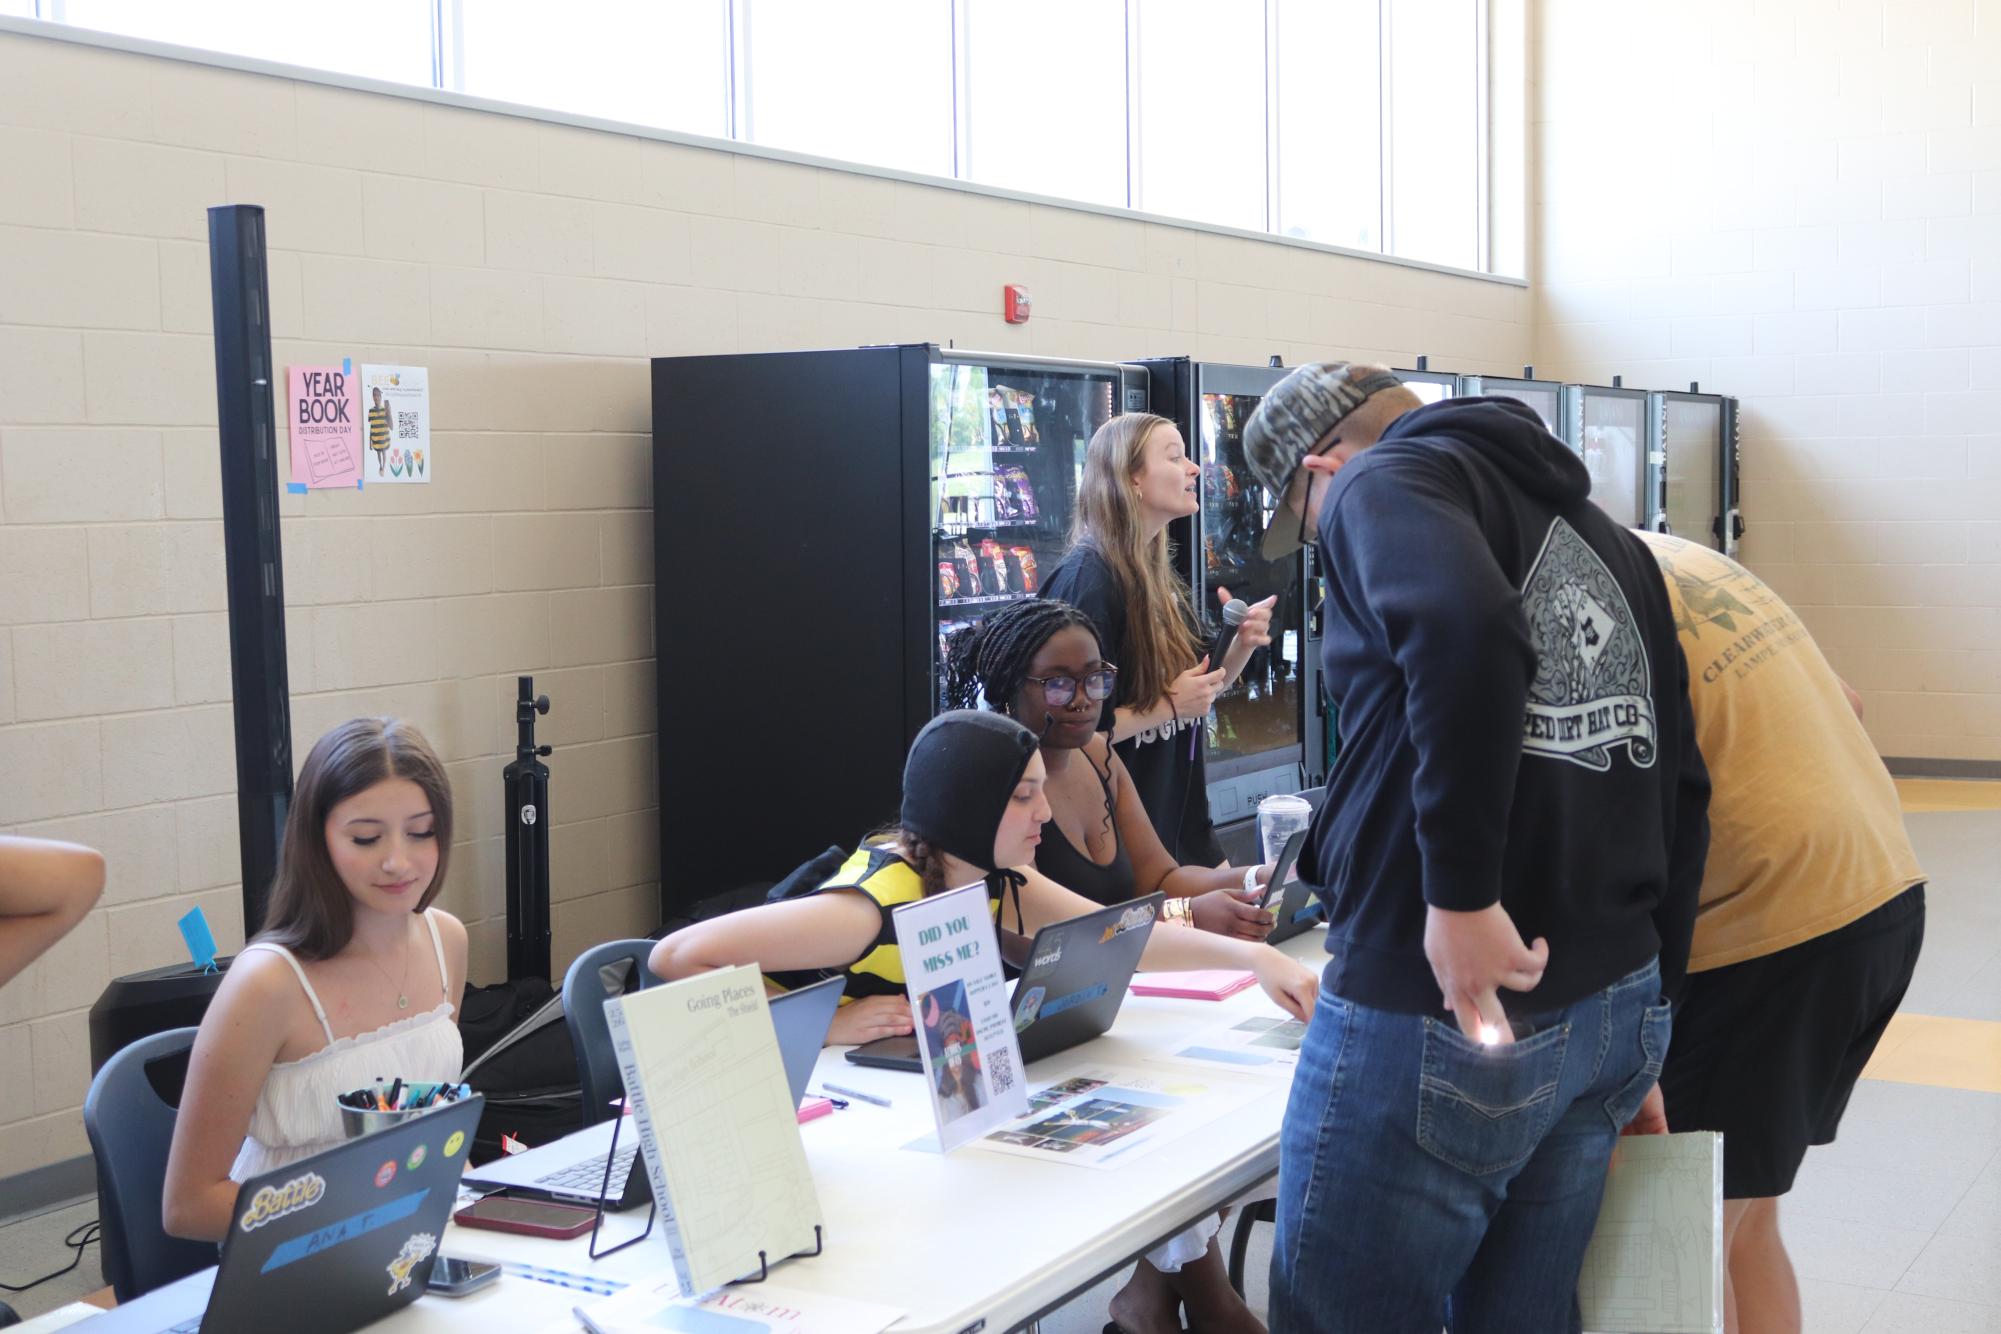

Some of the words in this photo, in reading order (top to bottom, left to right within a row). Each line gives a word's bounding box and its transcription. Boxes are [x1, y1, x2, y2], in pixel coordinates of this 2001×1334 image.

[303, 373, 344, 397] YEAR
[298, 399, 350, 424] BOOK
[298, 426, 338, 435] DISTRIBUTION
[339, 426, 352, 434] DAY
[1586, 705, 1611, 736] HAT
[918, 925, 942, 947] DID
[944, 915, 970, 937] YOU
[922, 949, 954, 974] MISS
[955, 940, 980, 962] ME?
[687, 993, 721, 1013] Going
[721, 985, 755, 1004] Places
[623, 1063, 645, 1115] Battle
[638, 1117, 657, 1161] High
[650, 1163, 675, 1224] School
[243, 1174, 324, 1229] Battle
[305, 1223, 348, 1255] ANA
